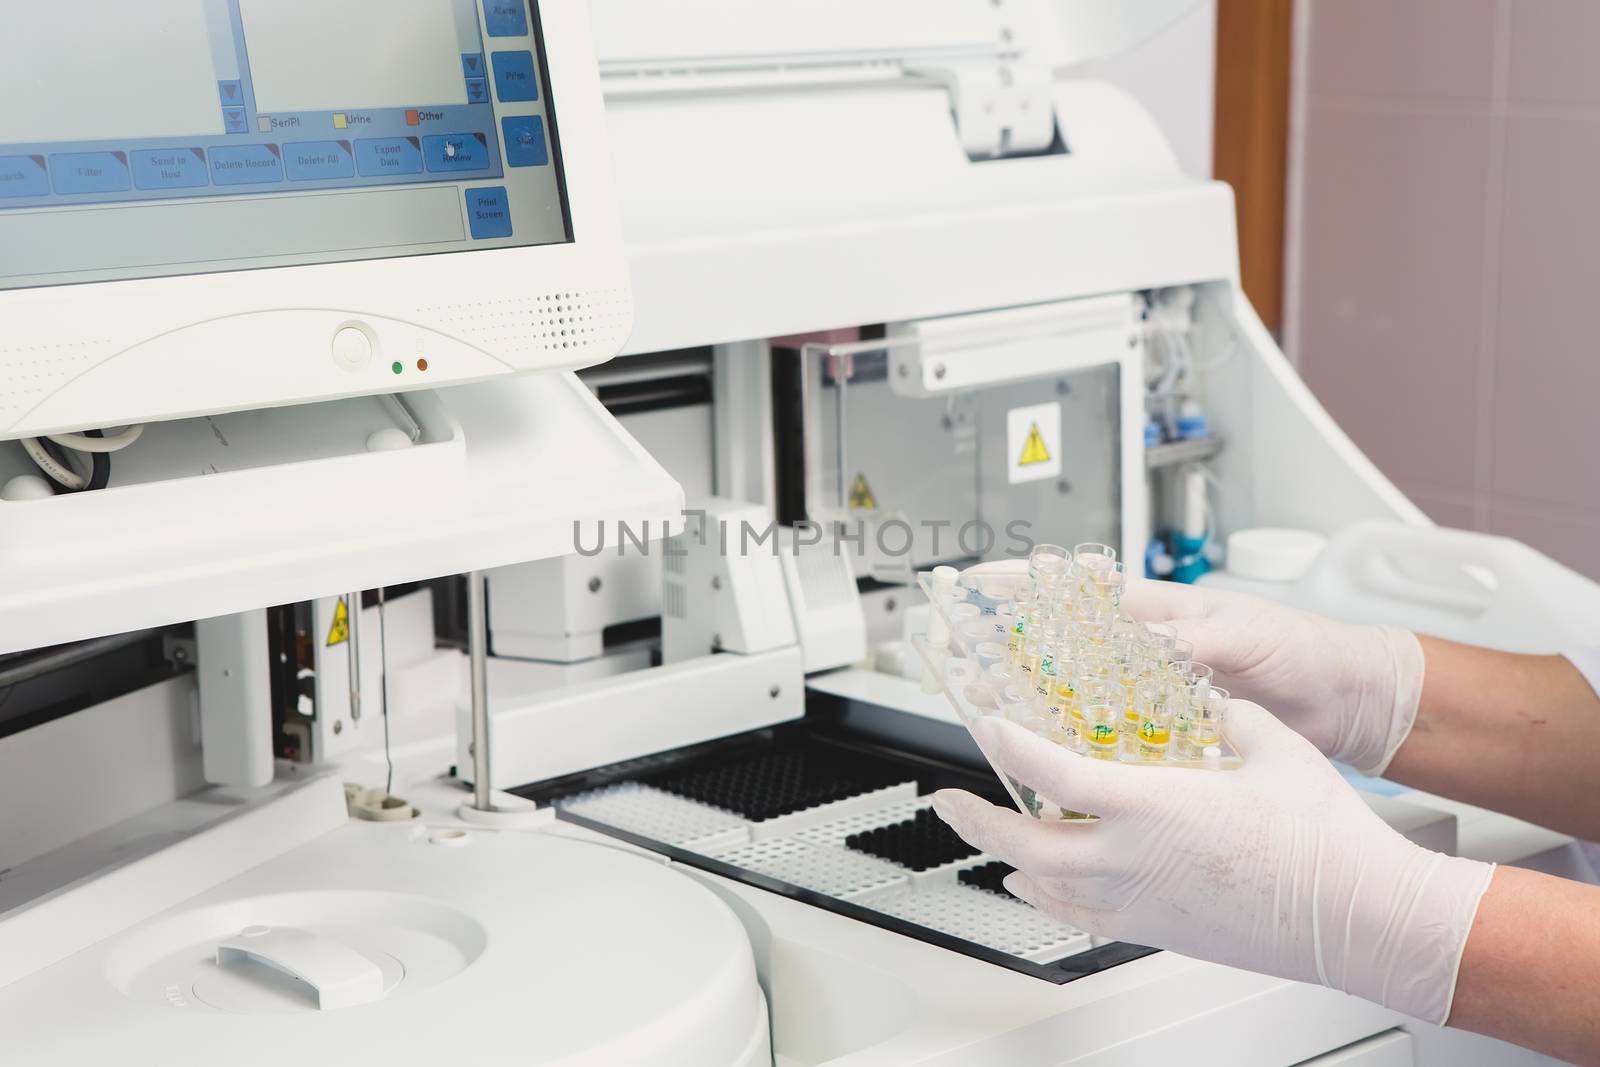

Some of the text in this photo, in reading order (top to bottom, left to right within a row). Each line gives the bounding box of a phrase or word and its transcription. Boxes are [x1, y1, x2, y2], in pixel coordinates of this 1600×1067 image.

[347, 115, 371, 125] Urine
[418, 111, 443, 121] Other
[375, 145, 401, 155] Export
[151, 156, 175, 166] Send
[214, 158, 277, 170] Delete Record
[298, 155, 340, 166] Delete All
[381, 158, 399, 167] Data
[478, 198, 497, 207] Print
[475, 211, 504, 219] Screen
